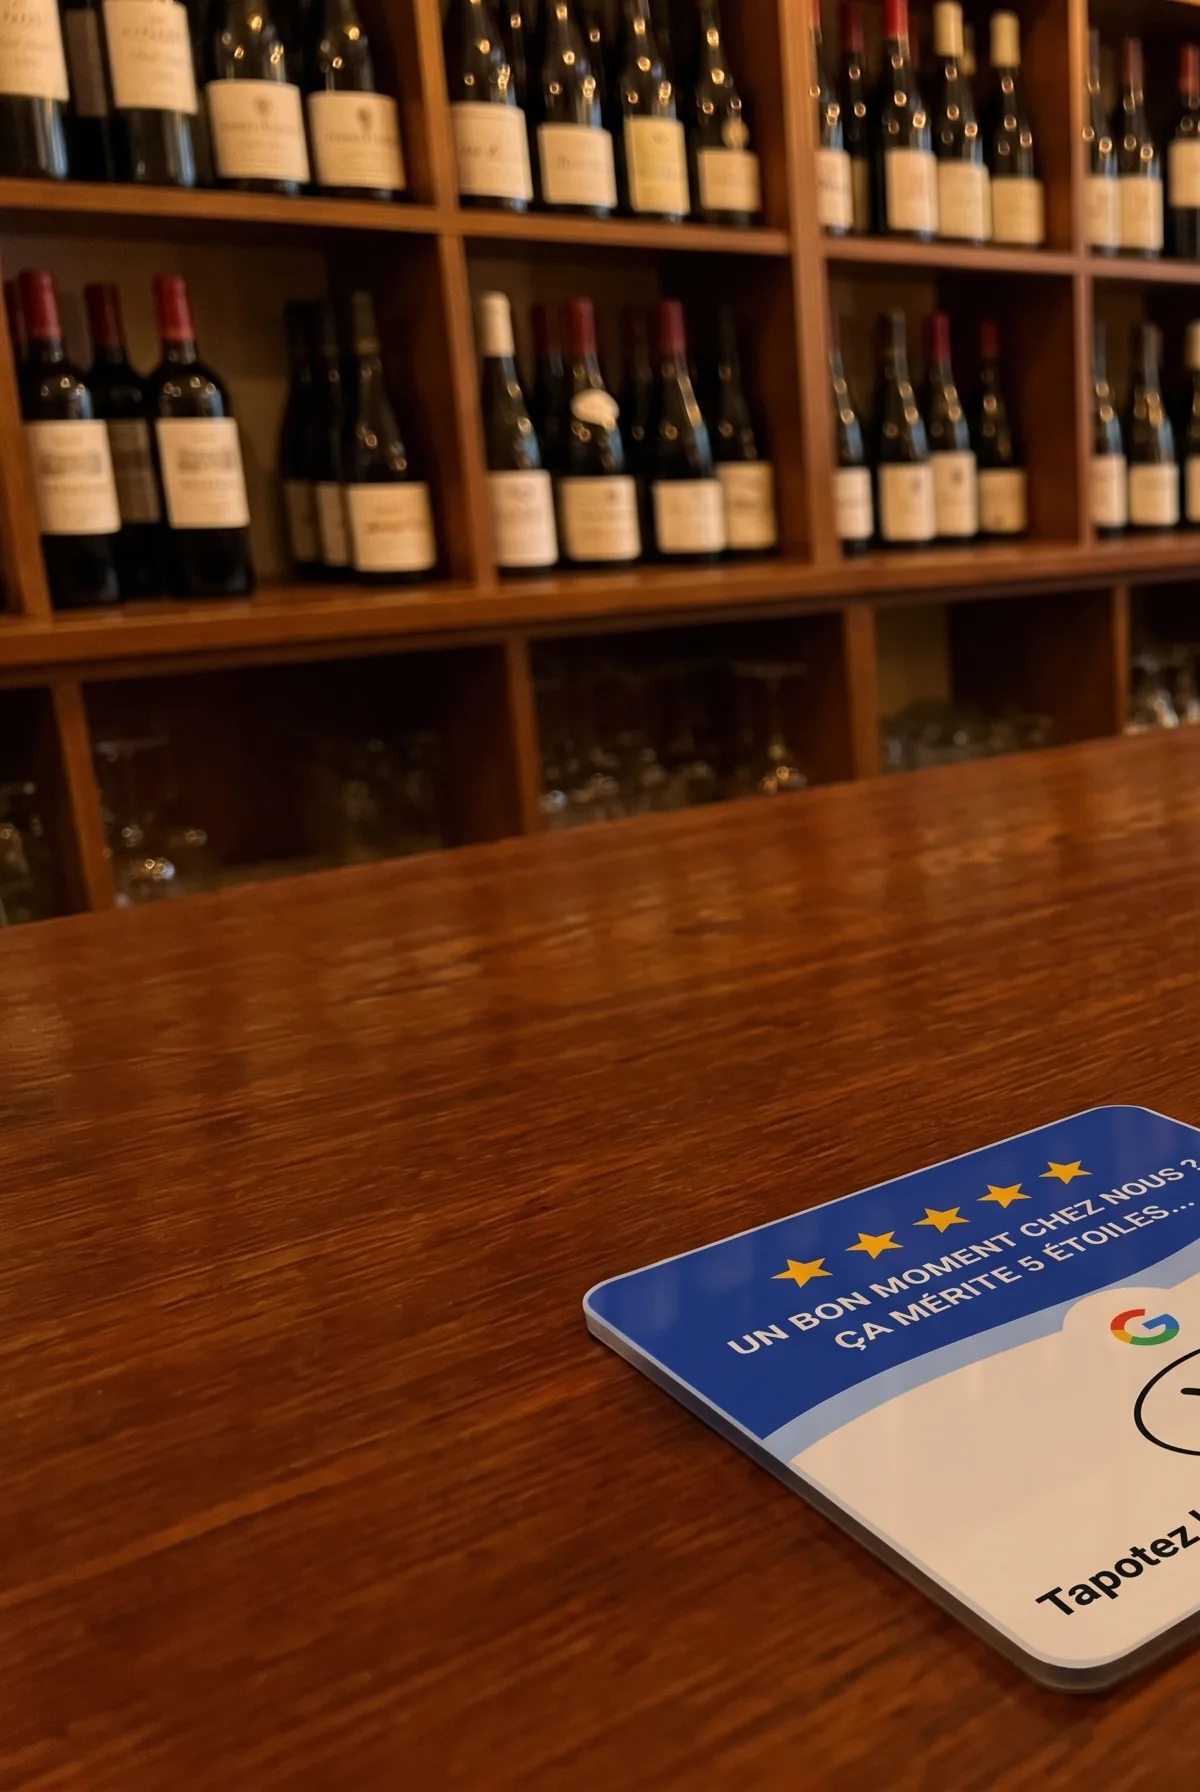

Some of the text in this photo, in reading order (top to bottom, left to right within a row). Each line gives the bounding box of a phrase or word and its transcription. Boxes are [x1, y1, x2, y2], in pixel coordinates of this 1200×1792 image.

[726, 1324, 790, 1355] UN
[787, 1291, 872, 1331] BON
[868, 1231, 1018, 1299] MOMENT
[1019, 1199, 1106, 1238] CHEZ
[1098, 1167, 1185, 1206] NOUS
[834, 1201, 1195, 1352] ÇA MÉRITE 5 ÉTOILES...
[1035, 1525, 1200, 1616] Tapotez
